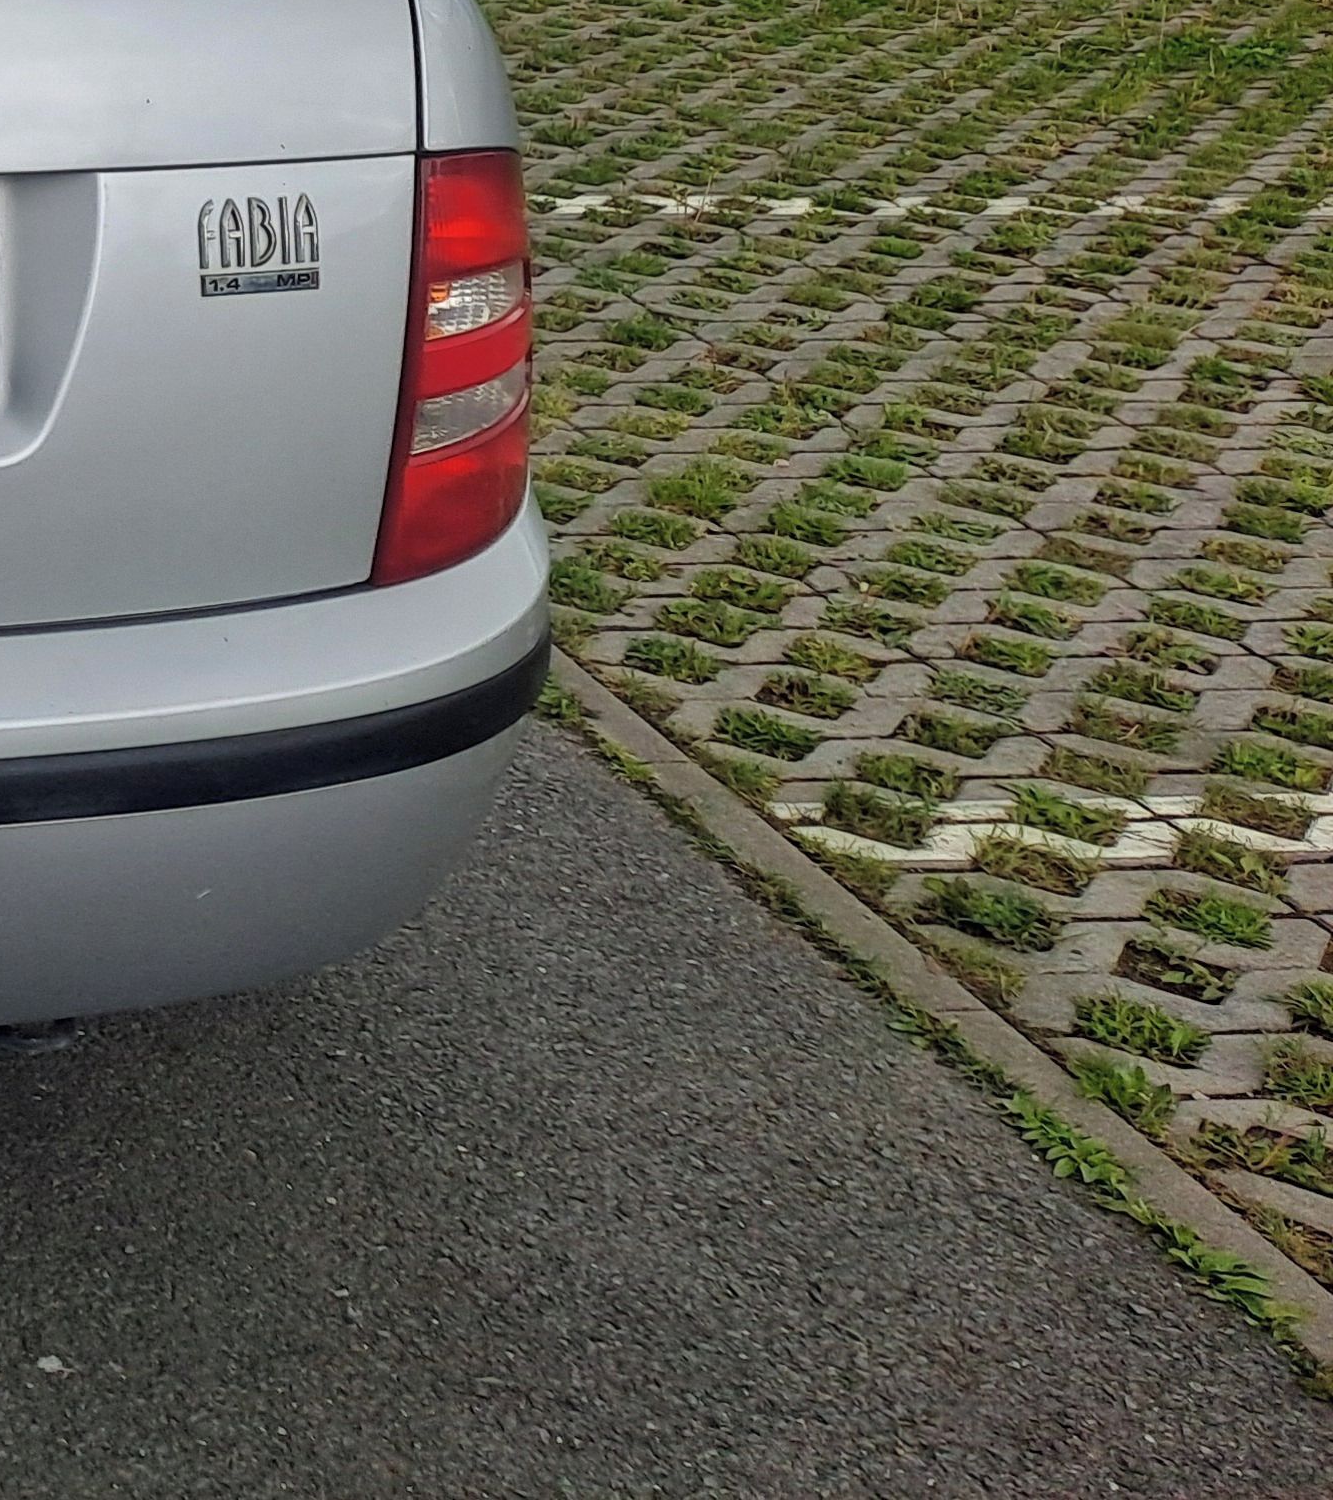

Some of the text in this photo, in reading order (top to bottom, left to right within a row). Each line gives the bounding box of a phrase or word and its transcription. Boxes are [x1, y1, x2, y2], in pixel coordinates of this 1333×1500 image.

[197, 192, 320, 270] FABIA
[208, 273, 318, 292] 1.4 MPI
